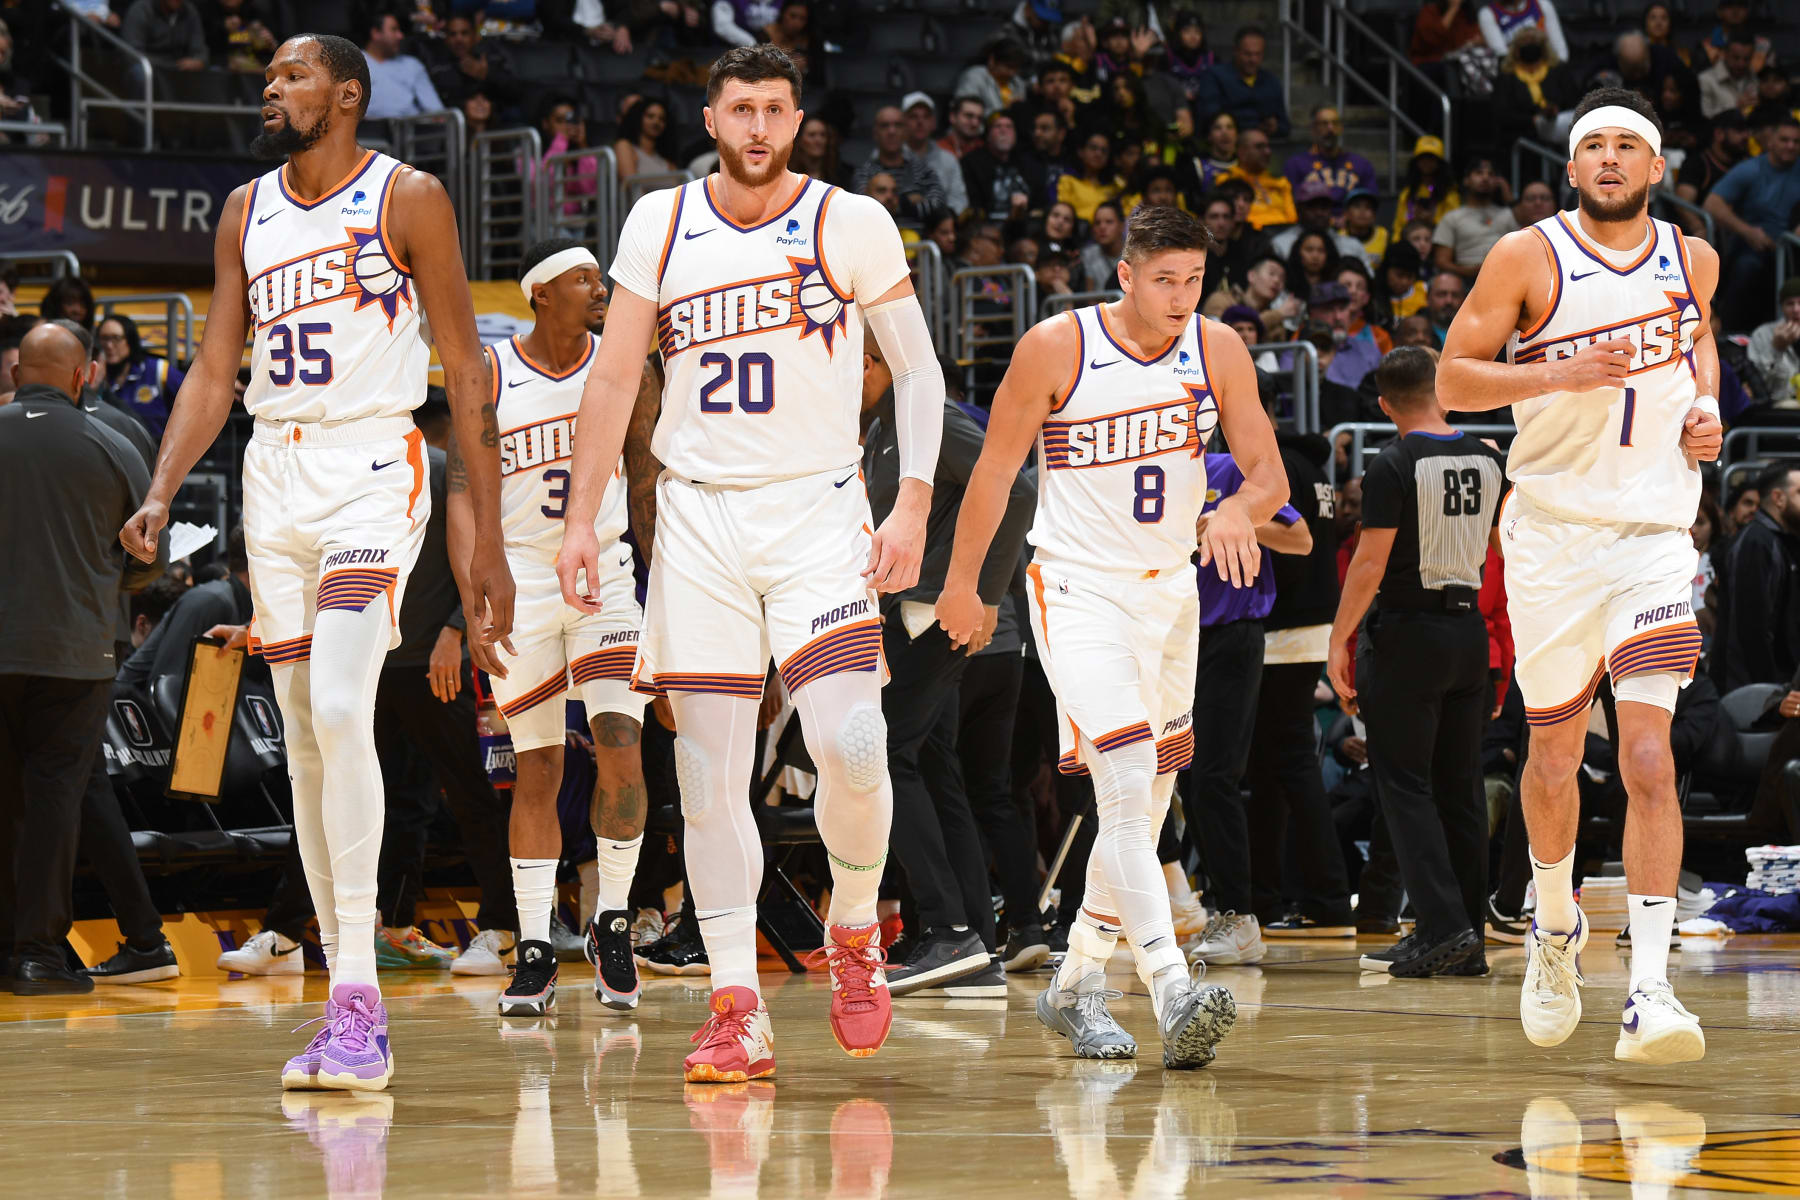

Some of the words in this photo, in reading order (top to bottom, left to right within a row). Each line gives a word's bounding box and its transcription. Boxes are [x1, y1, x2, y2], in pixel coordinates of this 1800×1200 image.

[341, 207, 372, 216] PayPal
[776, 236, 807, 246] PayPal
[1654, 273, 1681, 282] PayPal
[670, 279, 793, 350] SUNS
[267, 322, 334, 387] 35
[1173, 367, 1200, 376] PayPal
[700, 352, 775, 414] 20
[1068, 405, 1189, 467] SUNS
[1620, 388, 1637, 447] 1
[500, 417, 577, 476] SUN
[541, 469, 571, 519] 3
[1133, 465, 1166, 524] 8
[1443, 468, 1481, 516] 83
[324, 549, 390, 572] PHOENIX
[811, 599, 869, 634] PHOENIX
[1633, 601, 1690, 630] PHOENIX
